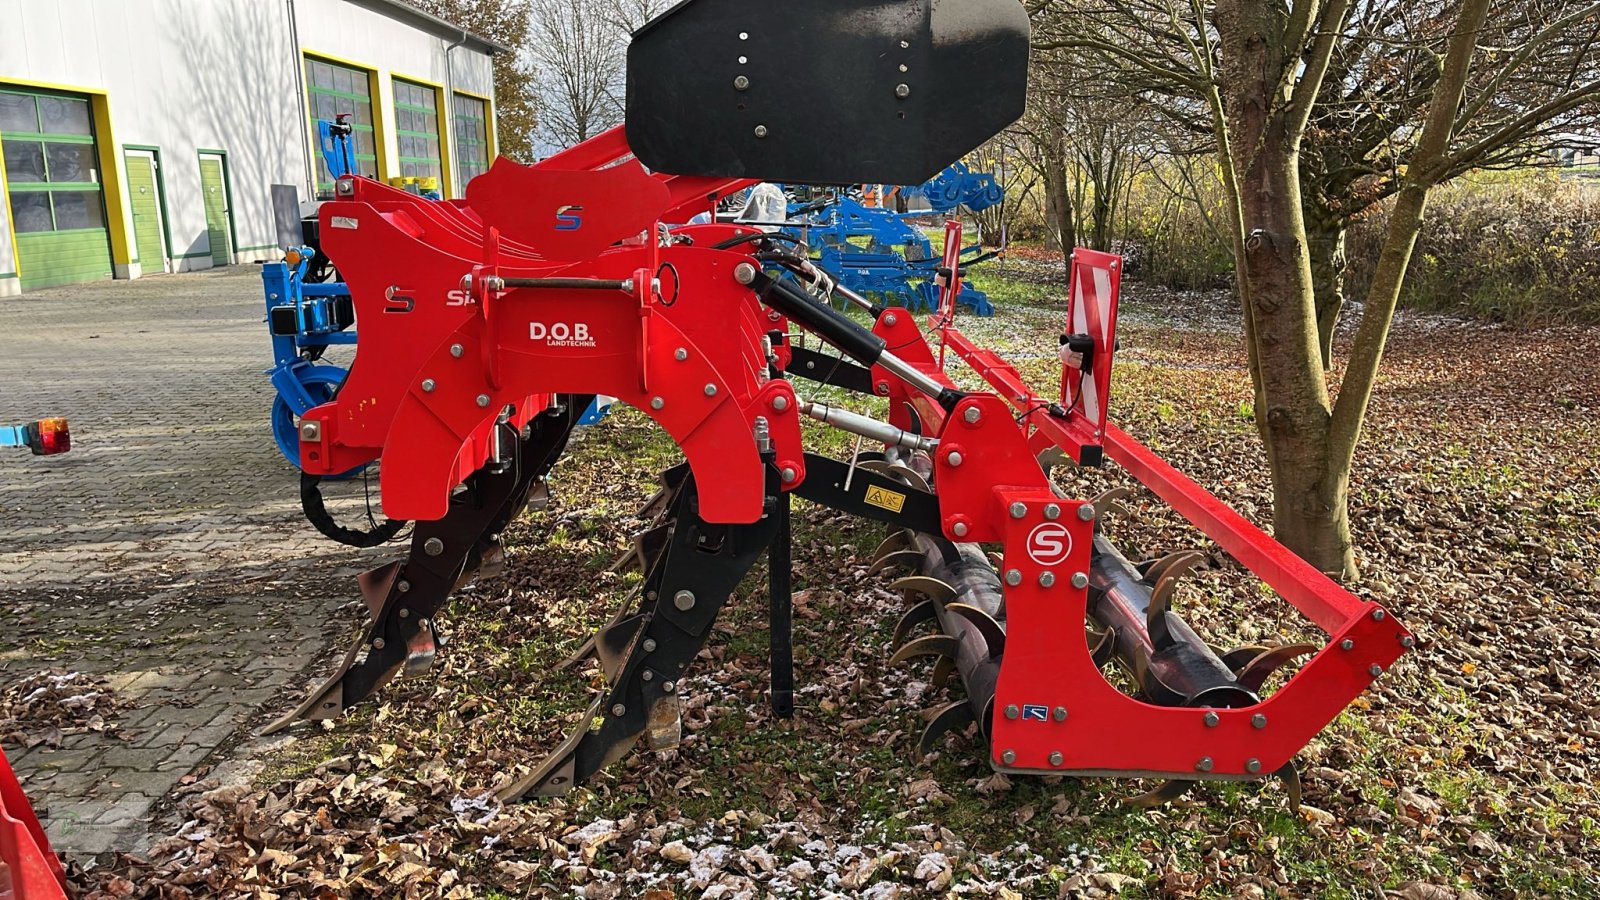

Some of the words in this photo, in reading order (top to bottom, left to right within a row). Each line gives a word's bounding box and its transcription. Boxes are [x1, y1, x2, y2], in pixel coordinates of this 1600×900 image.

[555, 205, 582, 230] S
[383, 285, 415, 313] S
[529, 322, 593, 340] D.O.B.
[1032, 530, 1066, 556] S
